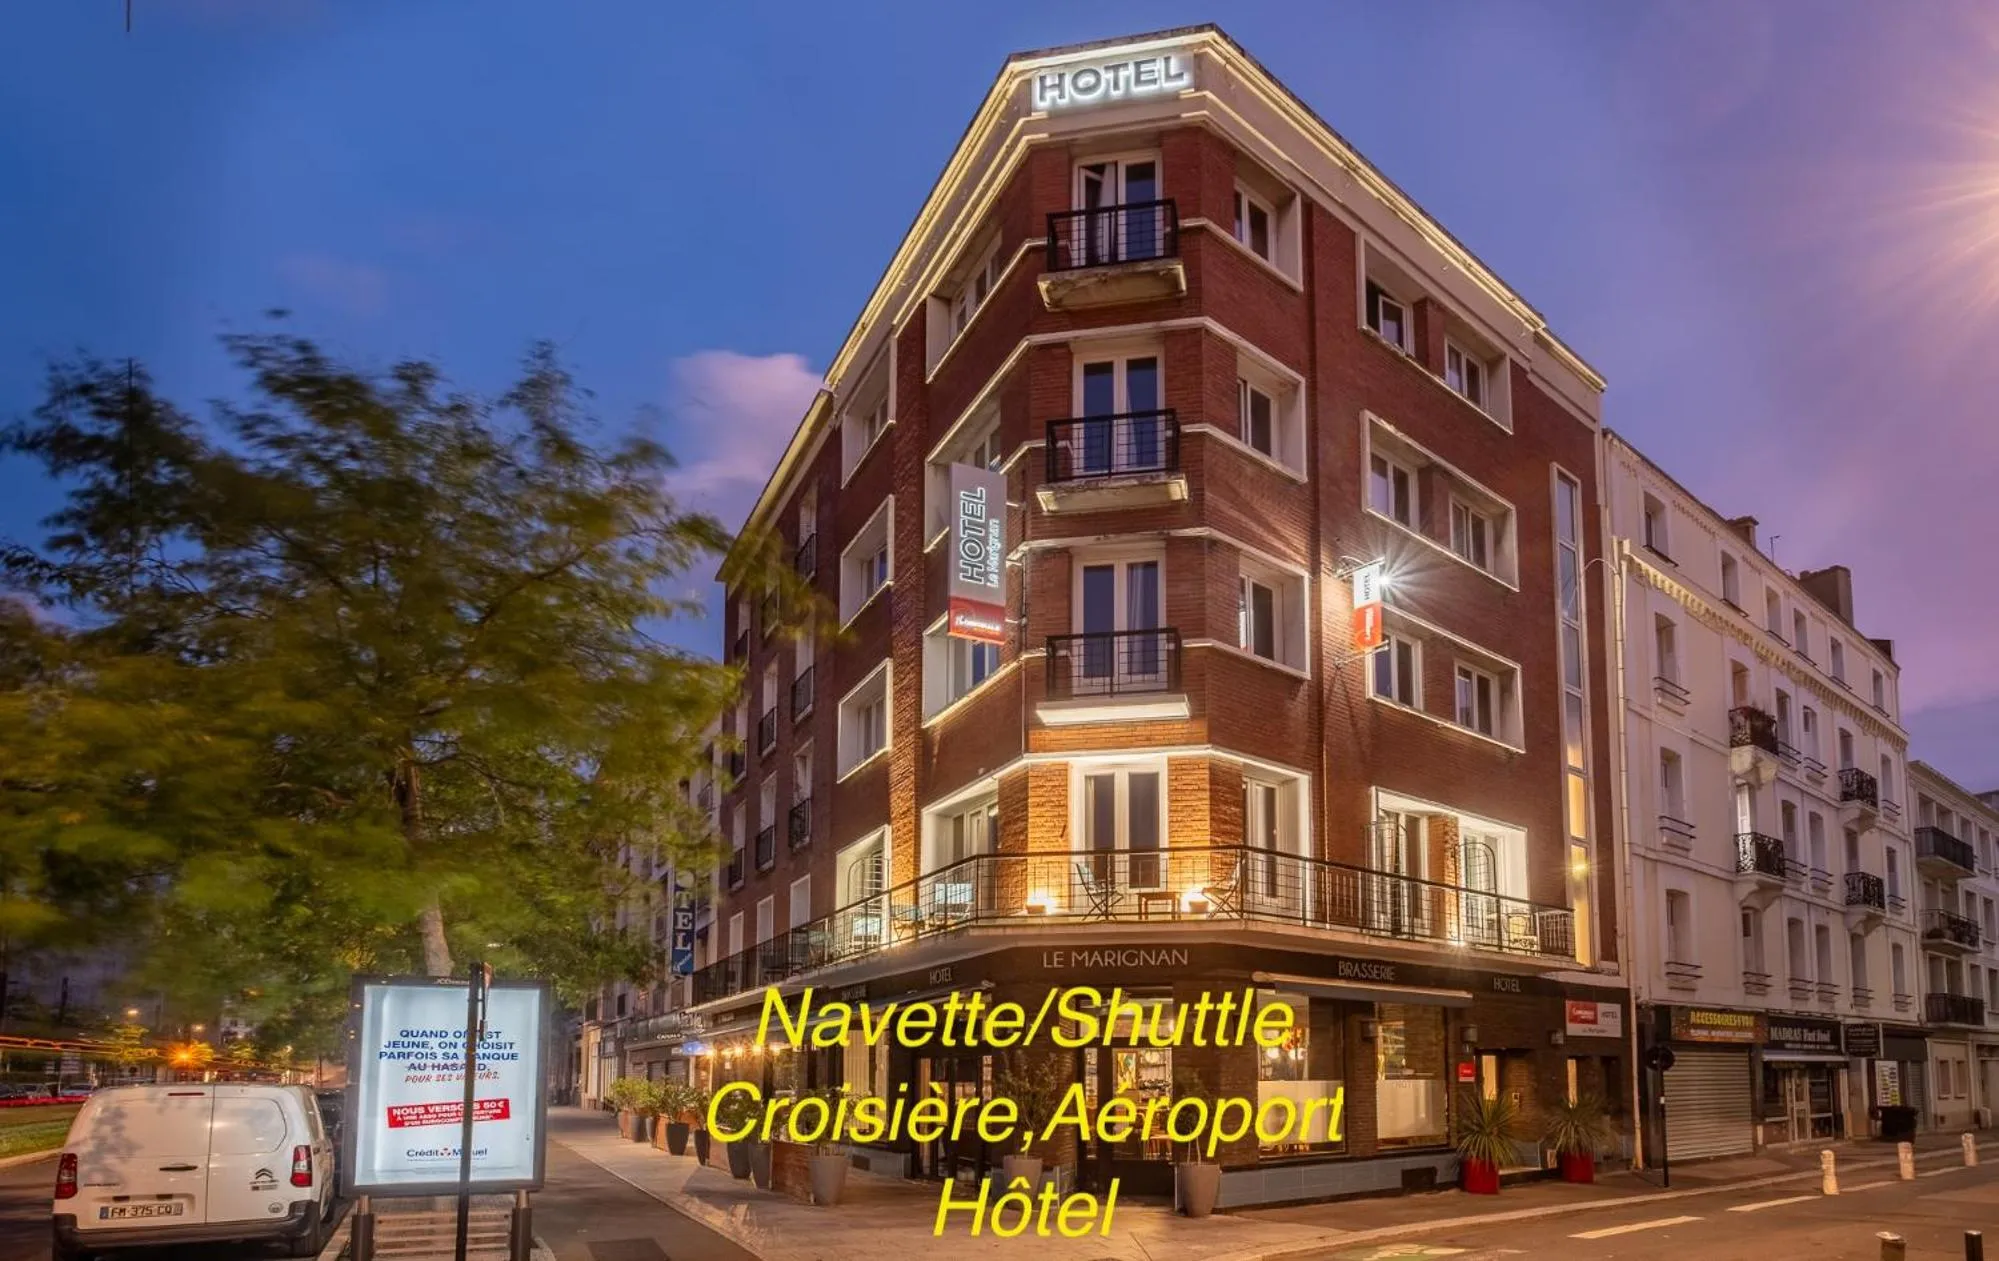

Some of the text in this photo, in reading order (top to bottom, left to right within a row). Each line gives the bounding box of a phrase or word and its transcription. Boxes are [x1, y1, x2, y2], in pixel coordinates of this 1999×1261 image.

[1038, 56, 1185, 102] HOTEL
[960, 486, 986, 585] HOTEL
[674, 868, 694, 951] OTEL
[1043, 949, 1188, 968] LE MARIGNAN
[929, 967, 952, 985] HOTEL
[1338, 960, 1396, 981] BRASSERIE
[1494, 977, 1521, 993] HOTEL
[399, 1030, 449, 1039] QUAND
[476, 1031, 502, 1039] ST
[384, 1041, 434, 1050] JEUNE,
[438, 1041, 458, 1049] ON
[379, 1051, 519, 1061] PARFOIS SA ANQUE
[408, 1062, 491, 1072] AU HASAD.
[404, 1074, 433, 1083] POUR
[393, 1106, 425, 1118] NOUS
[427, 1102, 480, 1114] VERSOS
[406, 1147, 488, 1157] Crédit Muel
